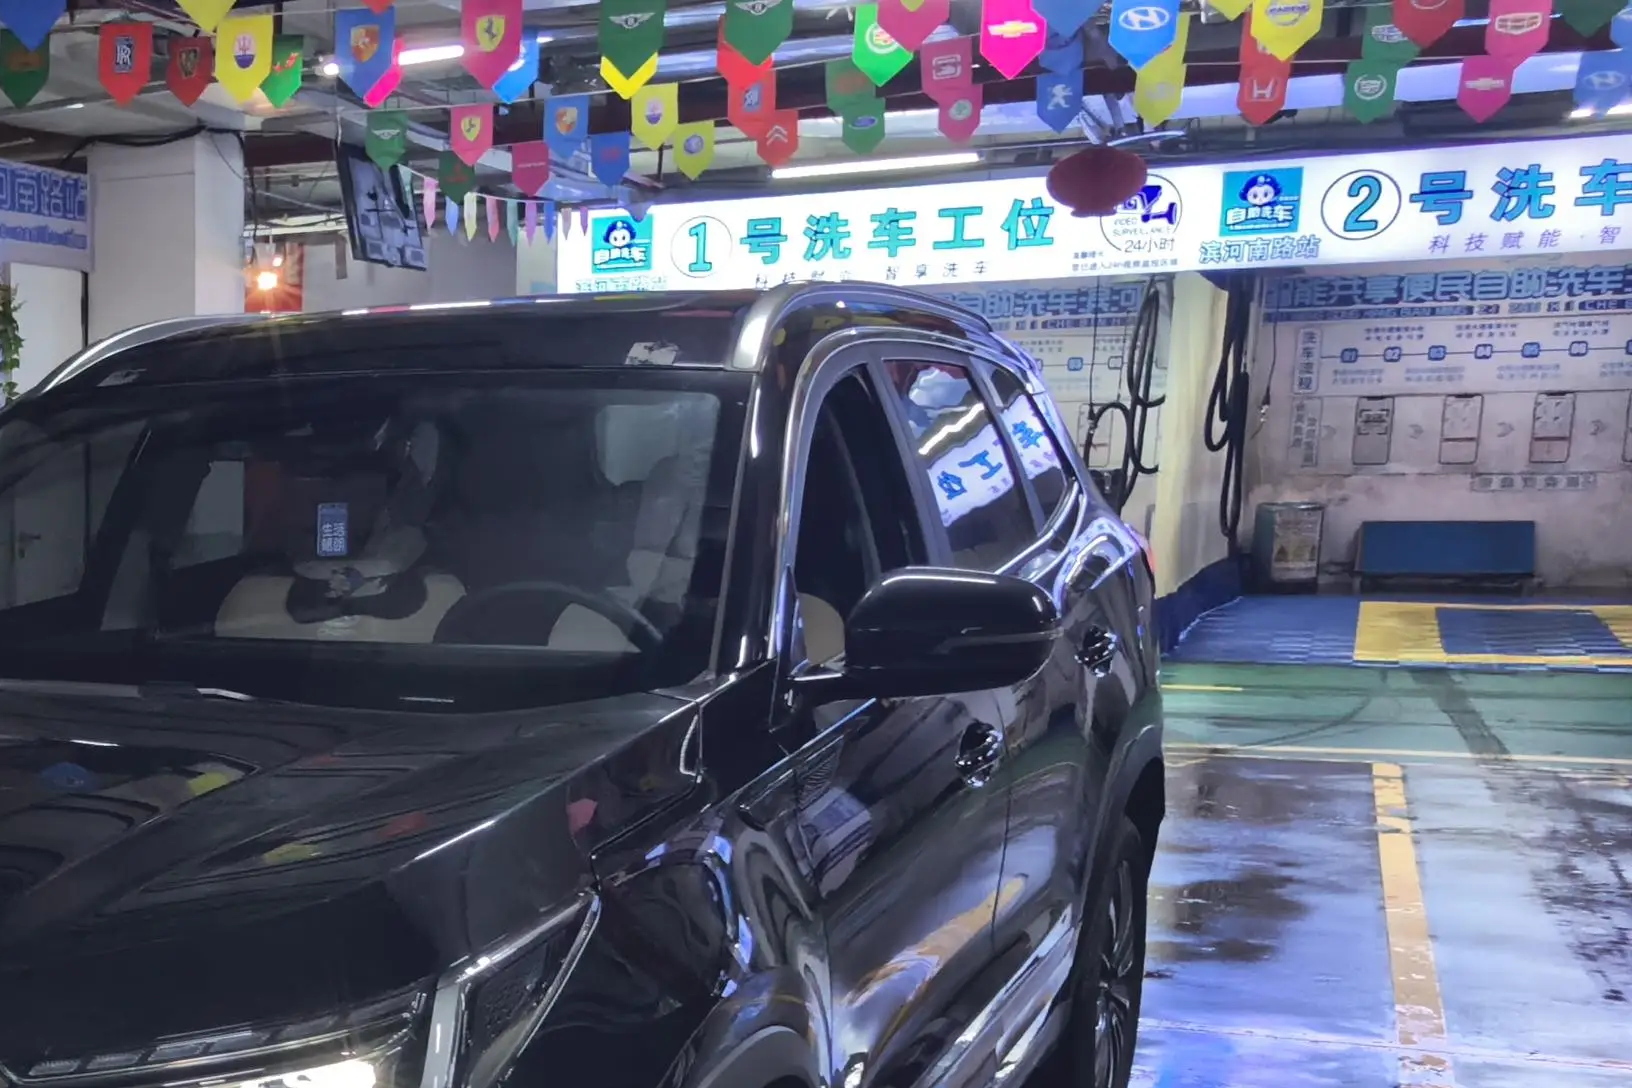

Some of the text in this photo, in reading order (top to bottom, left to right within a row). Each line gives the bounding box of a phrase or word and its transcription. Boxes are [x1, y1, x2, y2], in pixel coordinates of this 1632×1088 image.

[1124, 237, 1175, 253] 24小时
[1199, 234, 1322, 264] 滨河南路站
[1585, 299, 1618, 310] CHE
